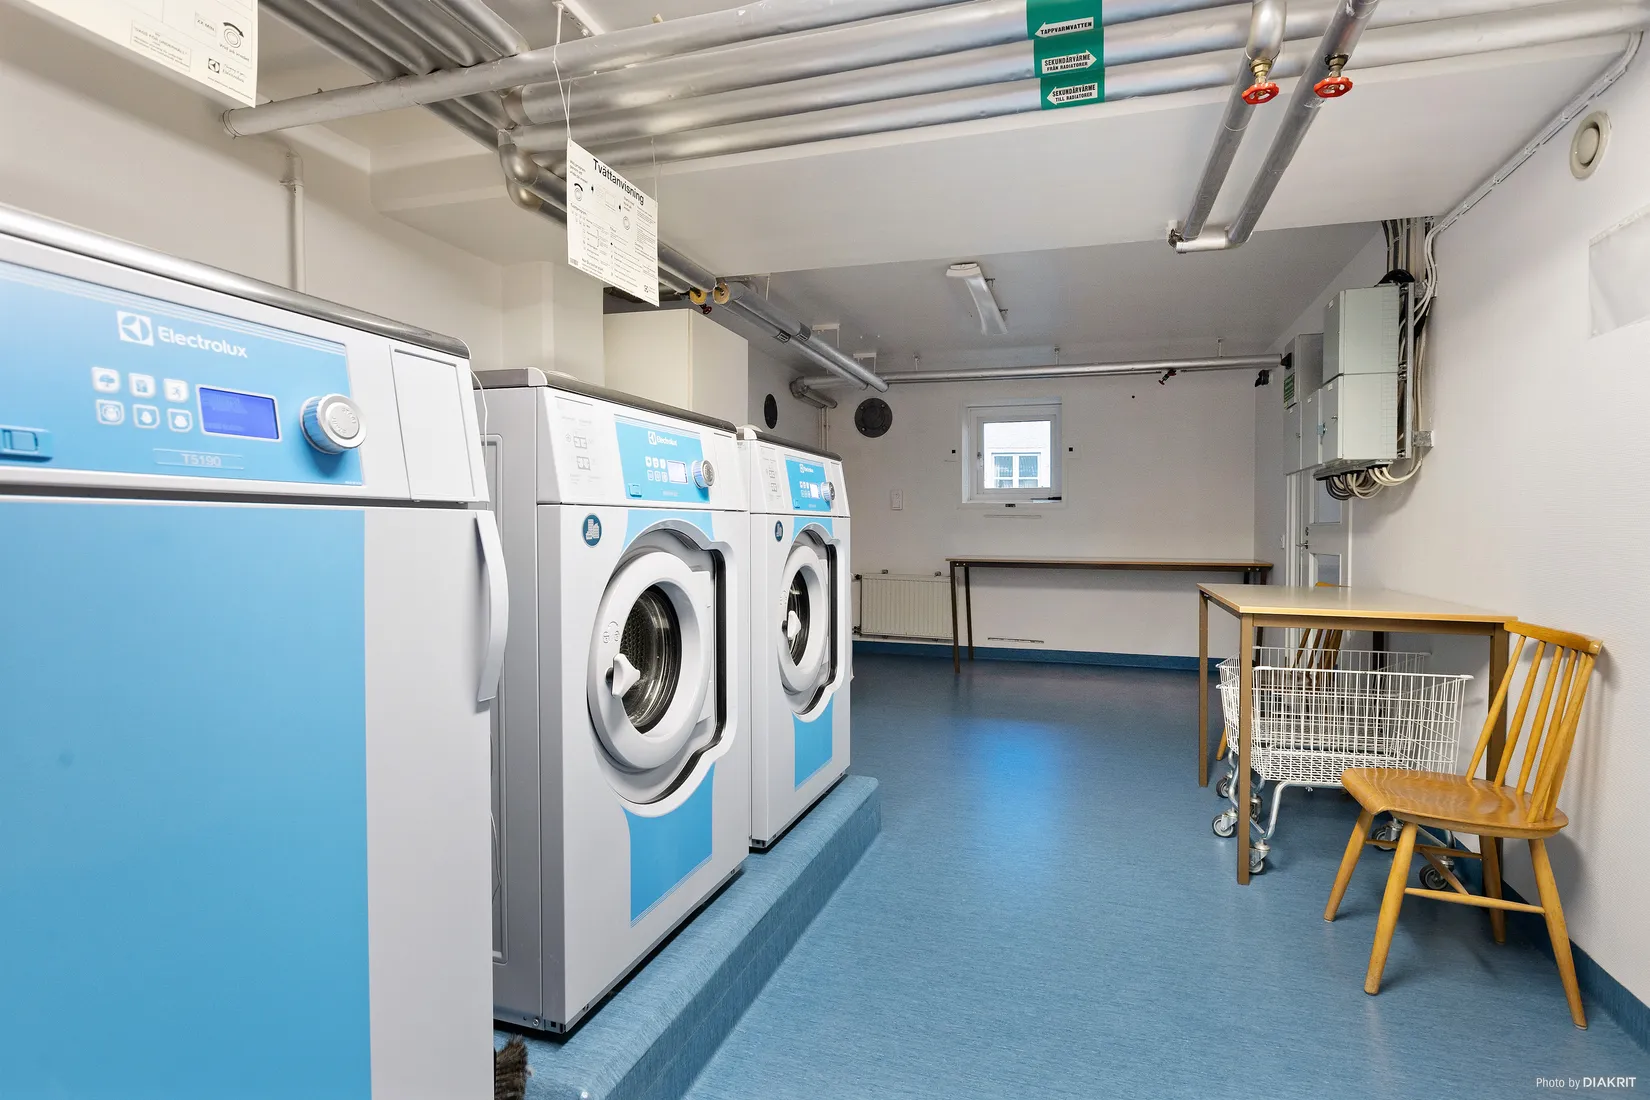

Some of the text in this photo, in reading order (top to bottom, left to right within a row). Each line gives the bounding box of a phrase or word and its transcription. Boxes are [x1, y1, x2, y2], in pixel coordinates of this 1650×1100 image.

[1041, 22, 1092, 34] TAPPVARMVATTEN
[1044, 54, 1090, 66] SEKUNDÄRVÄRME
[1060, 61, 1088, 70] RADIATORER
[1052, 84, 1096, 97] SEKUNDÄRVÄRME
[1066, 92, 1093, 100] RADIATORER
[593, 158, 645, 206] Tvättanvisning
[158, 326, 248, 359] Electrolux
[181, 453, 222, 467] T5190
